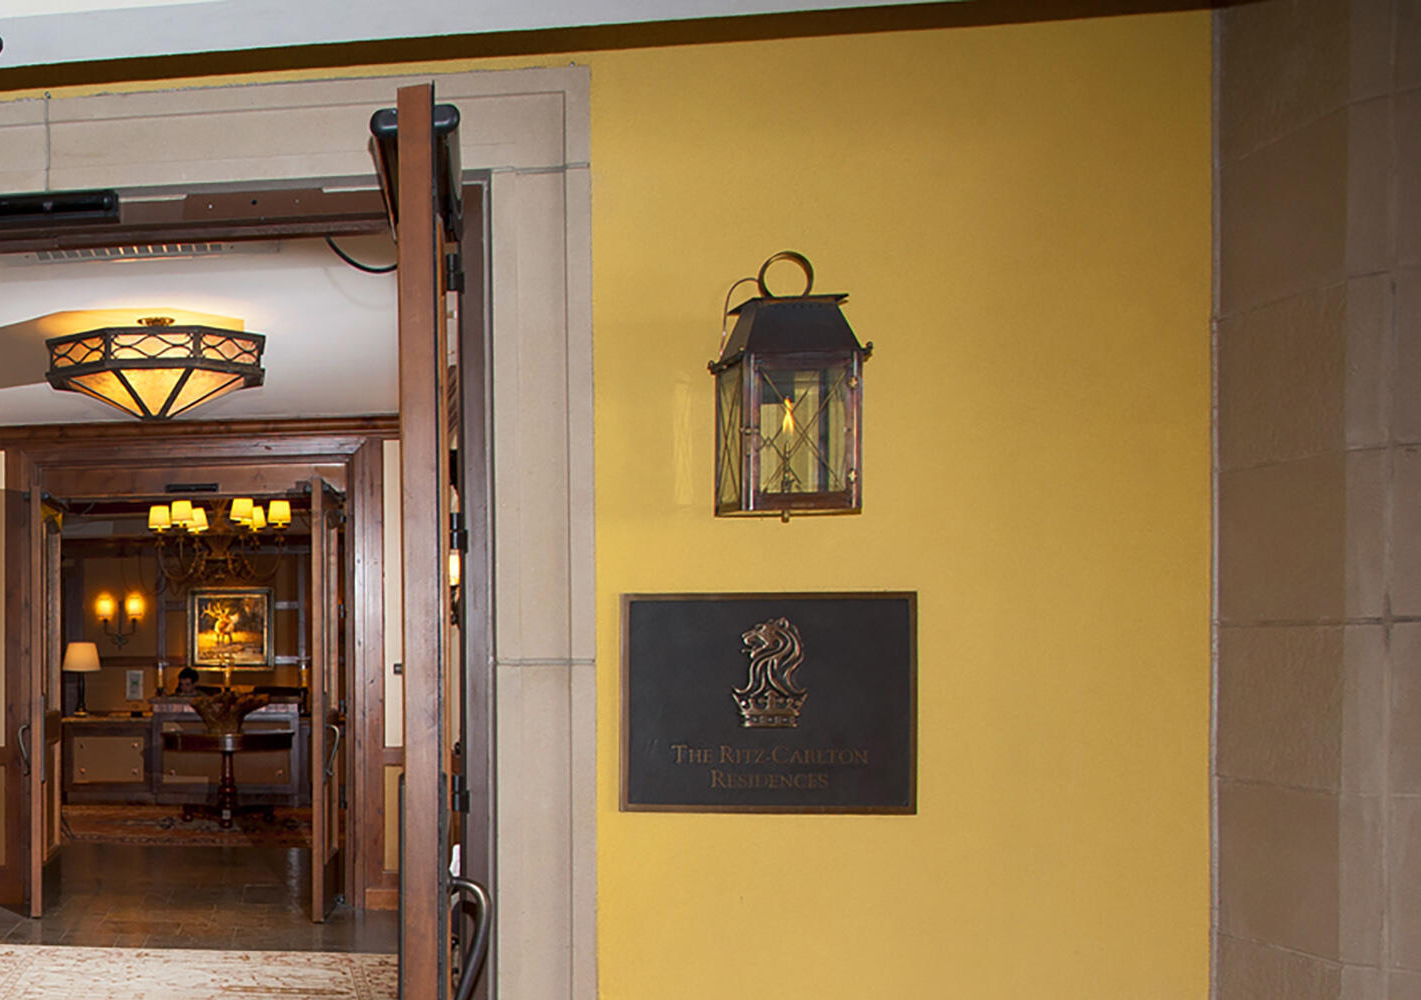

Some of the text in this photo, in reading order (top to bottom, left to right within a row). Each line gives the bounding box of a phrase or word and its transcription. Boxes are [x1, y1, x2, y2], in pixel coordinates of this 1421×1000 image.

[671, 744, 869, 765] THE RITZ-CARLTON
[711, 769, 828, 789] RESIDENCES
